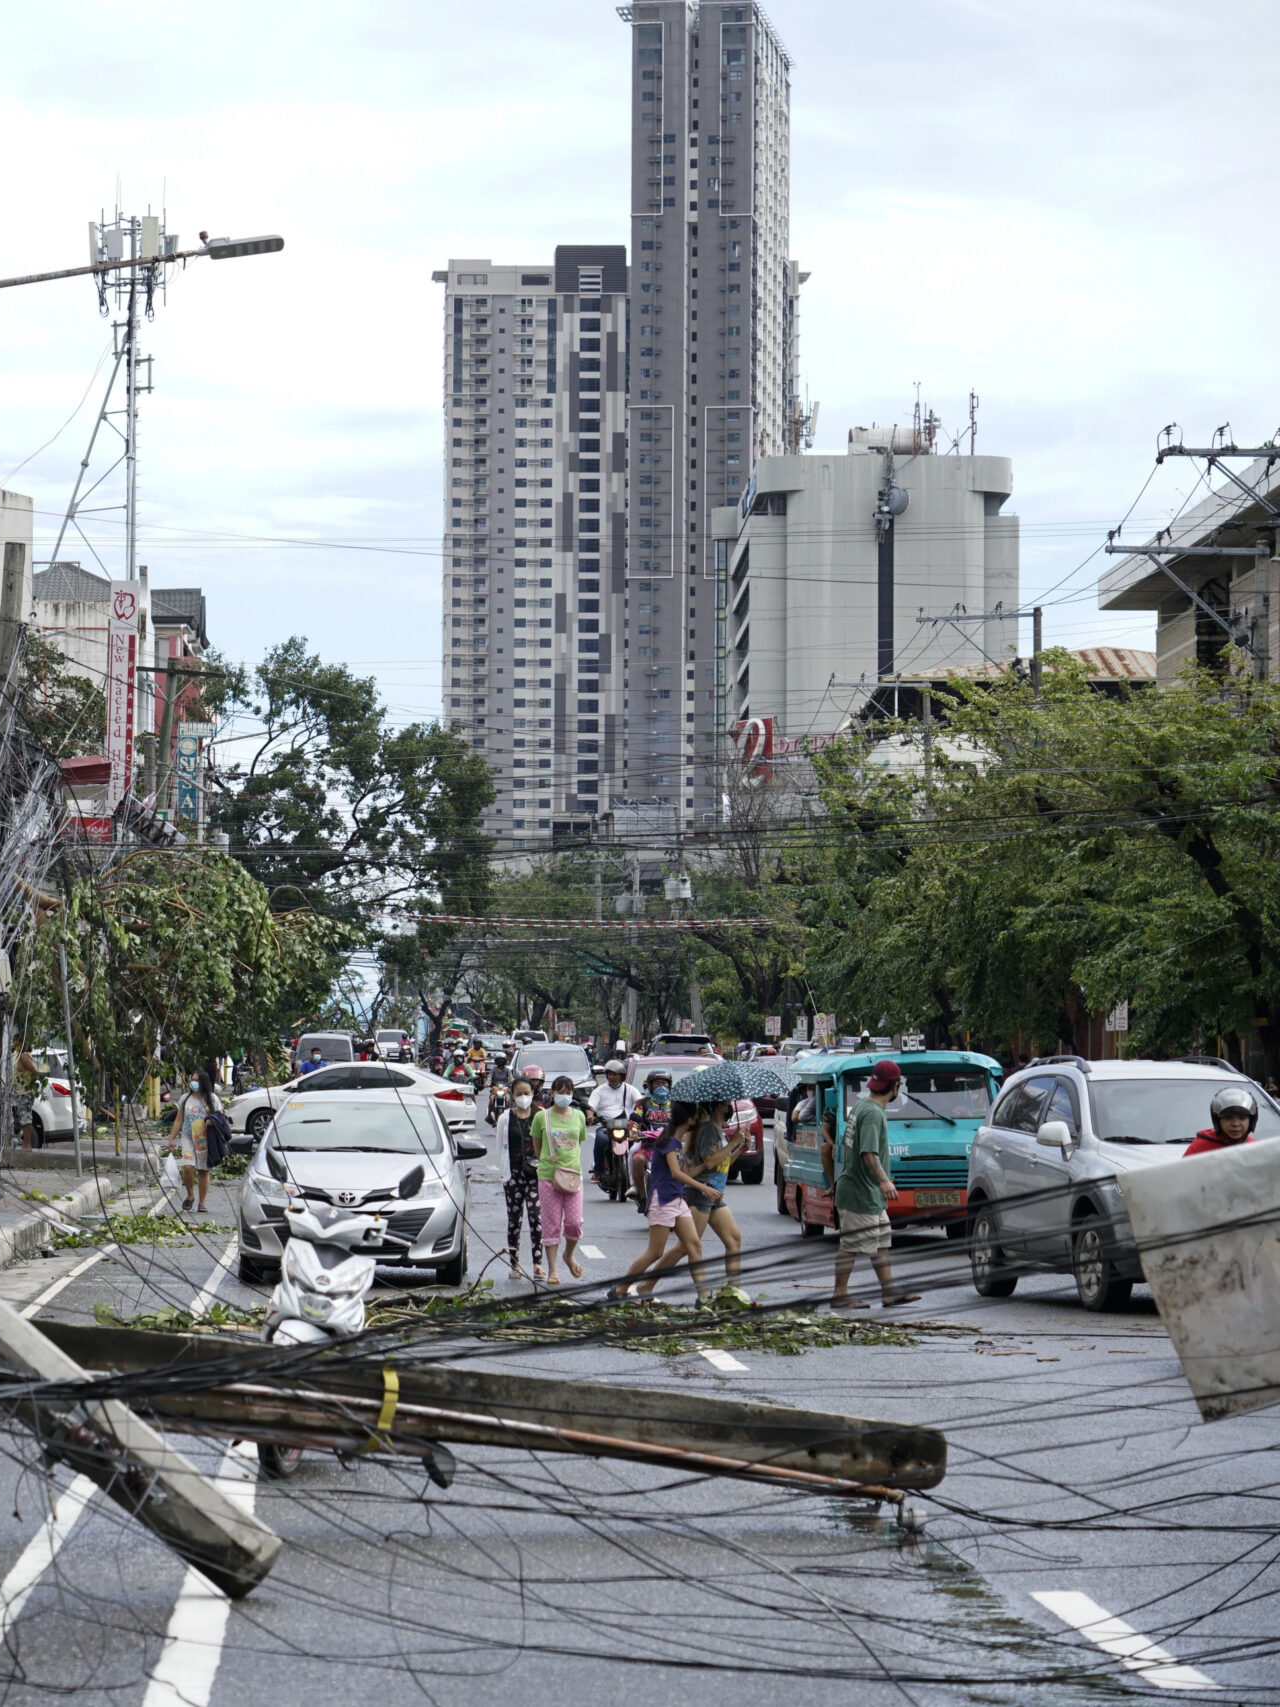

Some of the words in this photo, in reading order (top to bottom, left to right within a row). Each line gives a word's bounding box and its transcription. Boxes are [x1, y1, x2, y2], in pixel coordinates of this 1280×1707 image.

[114, 634, 125, 663] New
[113, 673, 123, 738] Sacred
[125, 662, 134, 776] PHARMACY
[111, 749, 122, 801] Heart
